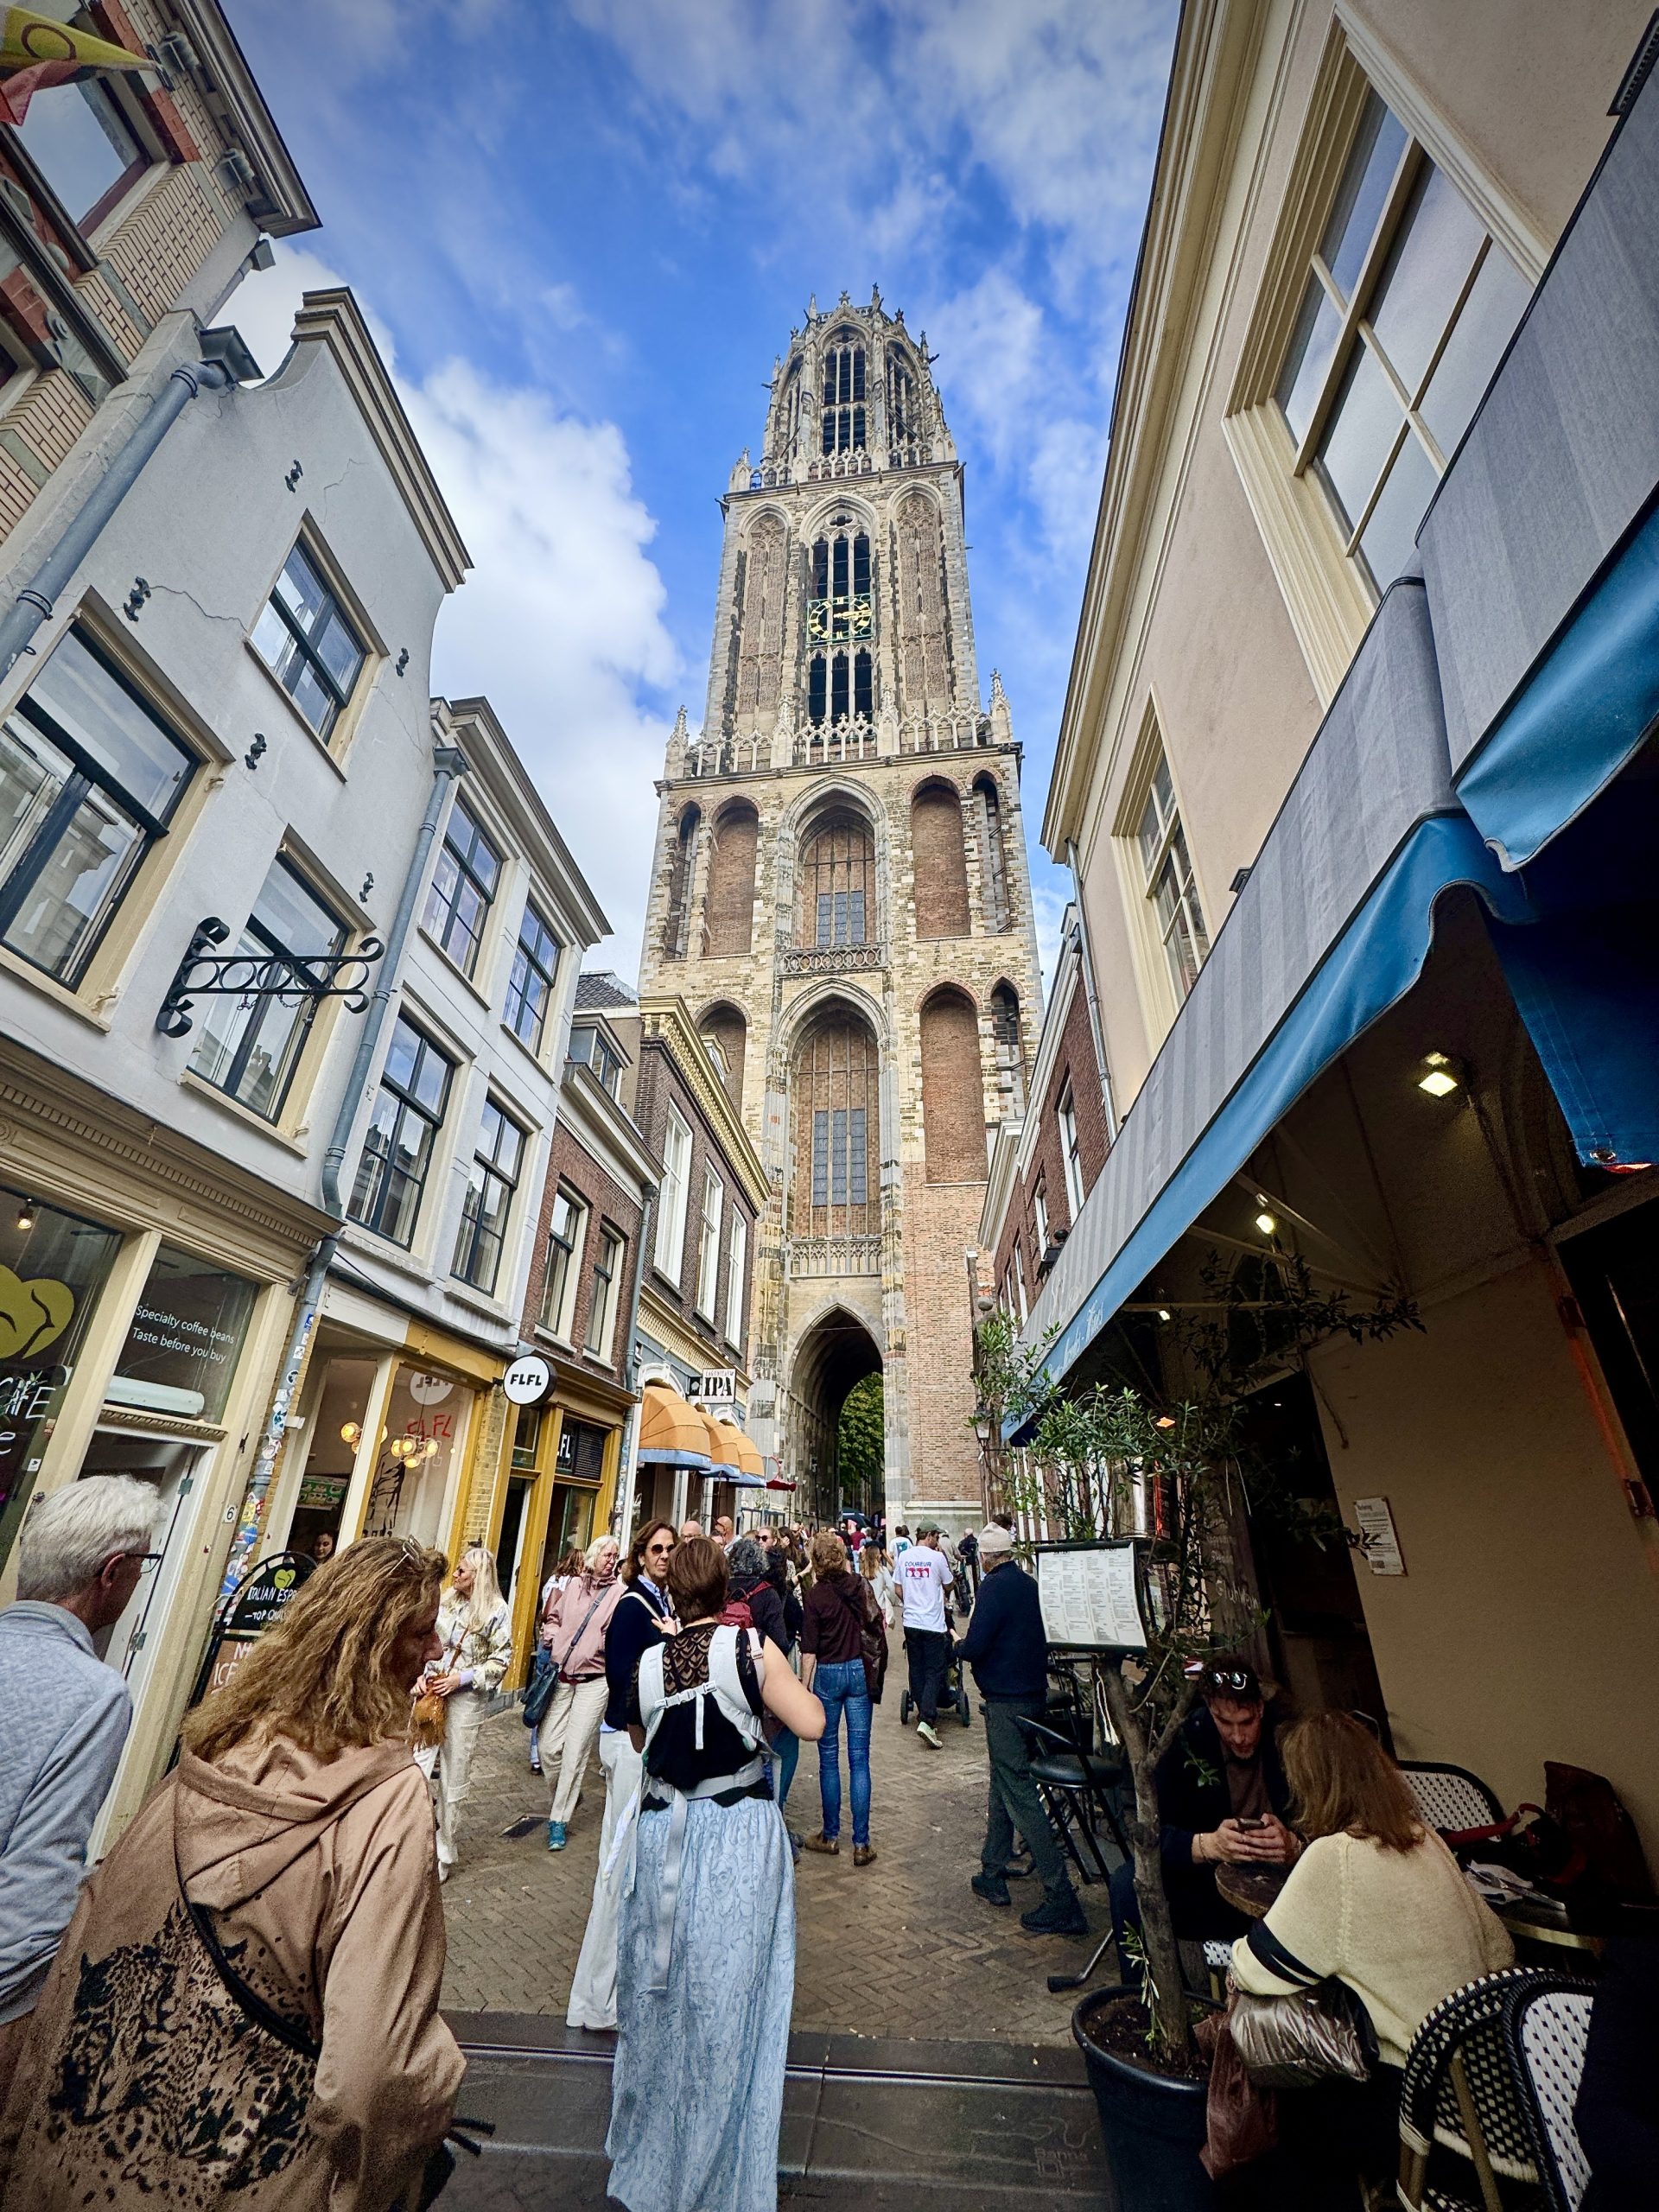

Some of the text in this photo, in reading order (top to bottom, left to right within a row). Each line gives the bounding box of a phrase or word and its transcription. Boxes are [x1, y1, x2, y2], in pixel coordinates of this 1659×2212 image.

[136, 1305, 235, 1344] Specialty coffee beans
[132, 1326, 226, 1364] Taste before you buy
[510, 1373, 542, 1386] FLFL
[703, 1376, 733, 1396] IPA
[226, 1506, 234, 1521] 6
[246, 1585, 276, 1601] ITALIAN
